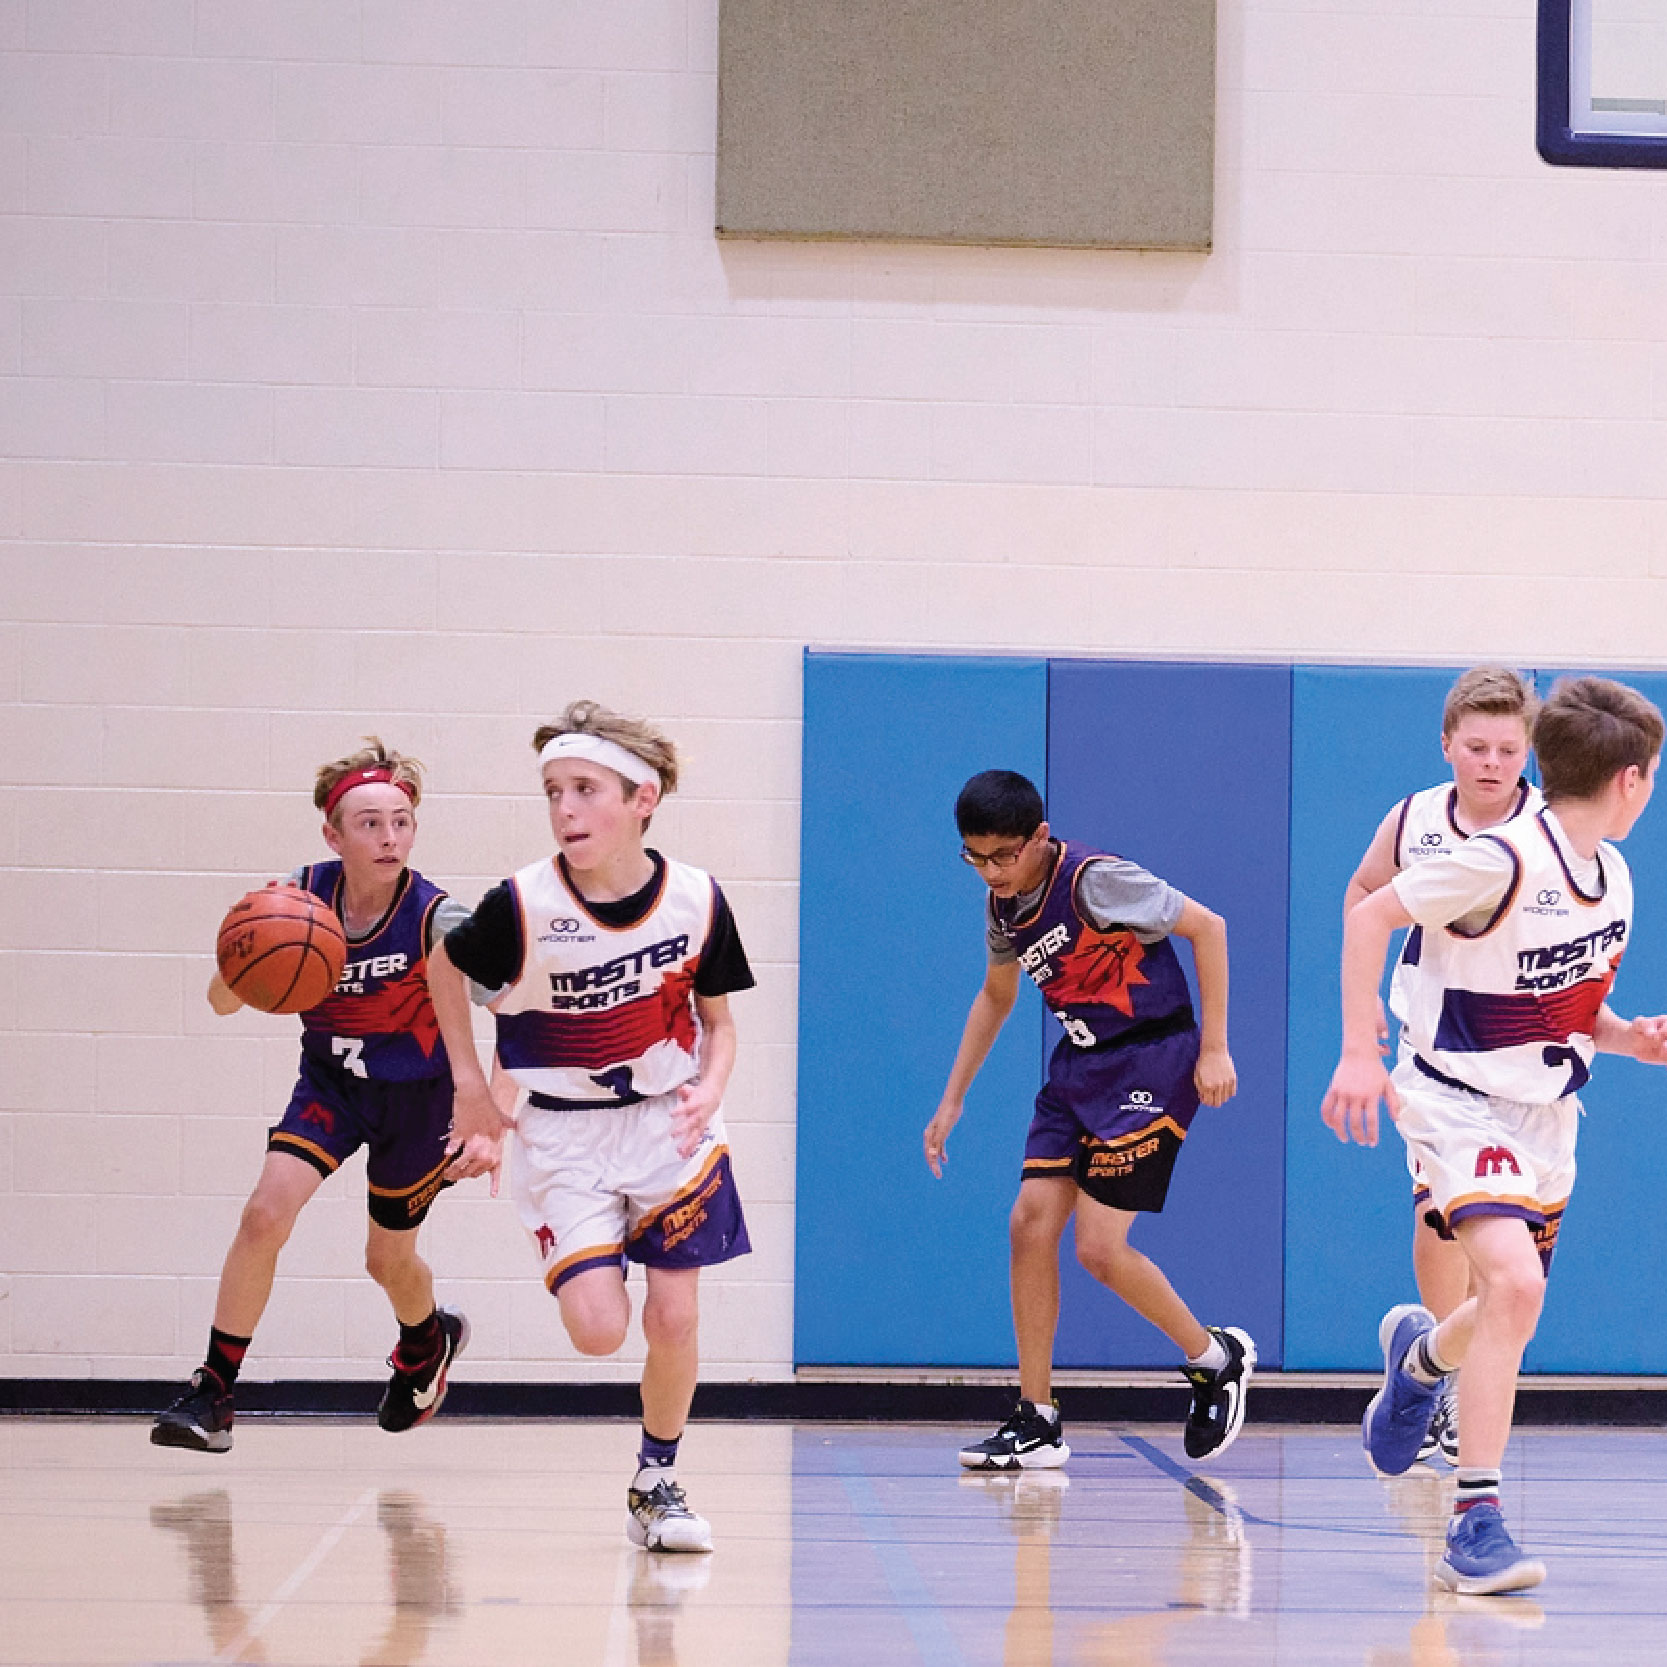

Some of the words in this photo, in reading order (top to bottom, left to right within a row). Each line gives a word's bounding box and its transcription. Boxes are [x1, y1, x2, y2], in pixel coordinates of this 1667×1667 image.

[340, 952, 408, 982] STER
[549, 933, 690, 993] MASTER
[1516, 918, 1626, 974] MASTER
[1513, 962, 1594, 992] SPORTS
